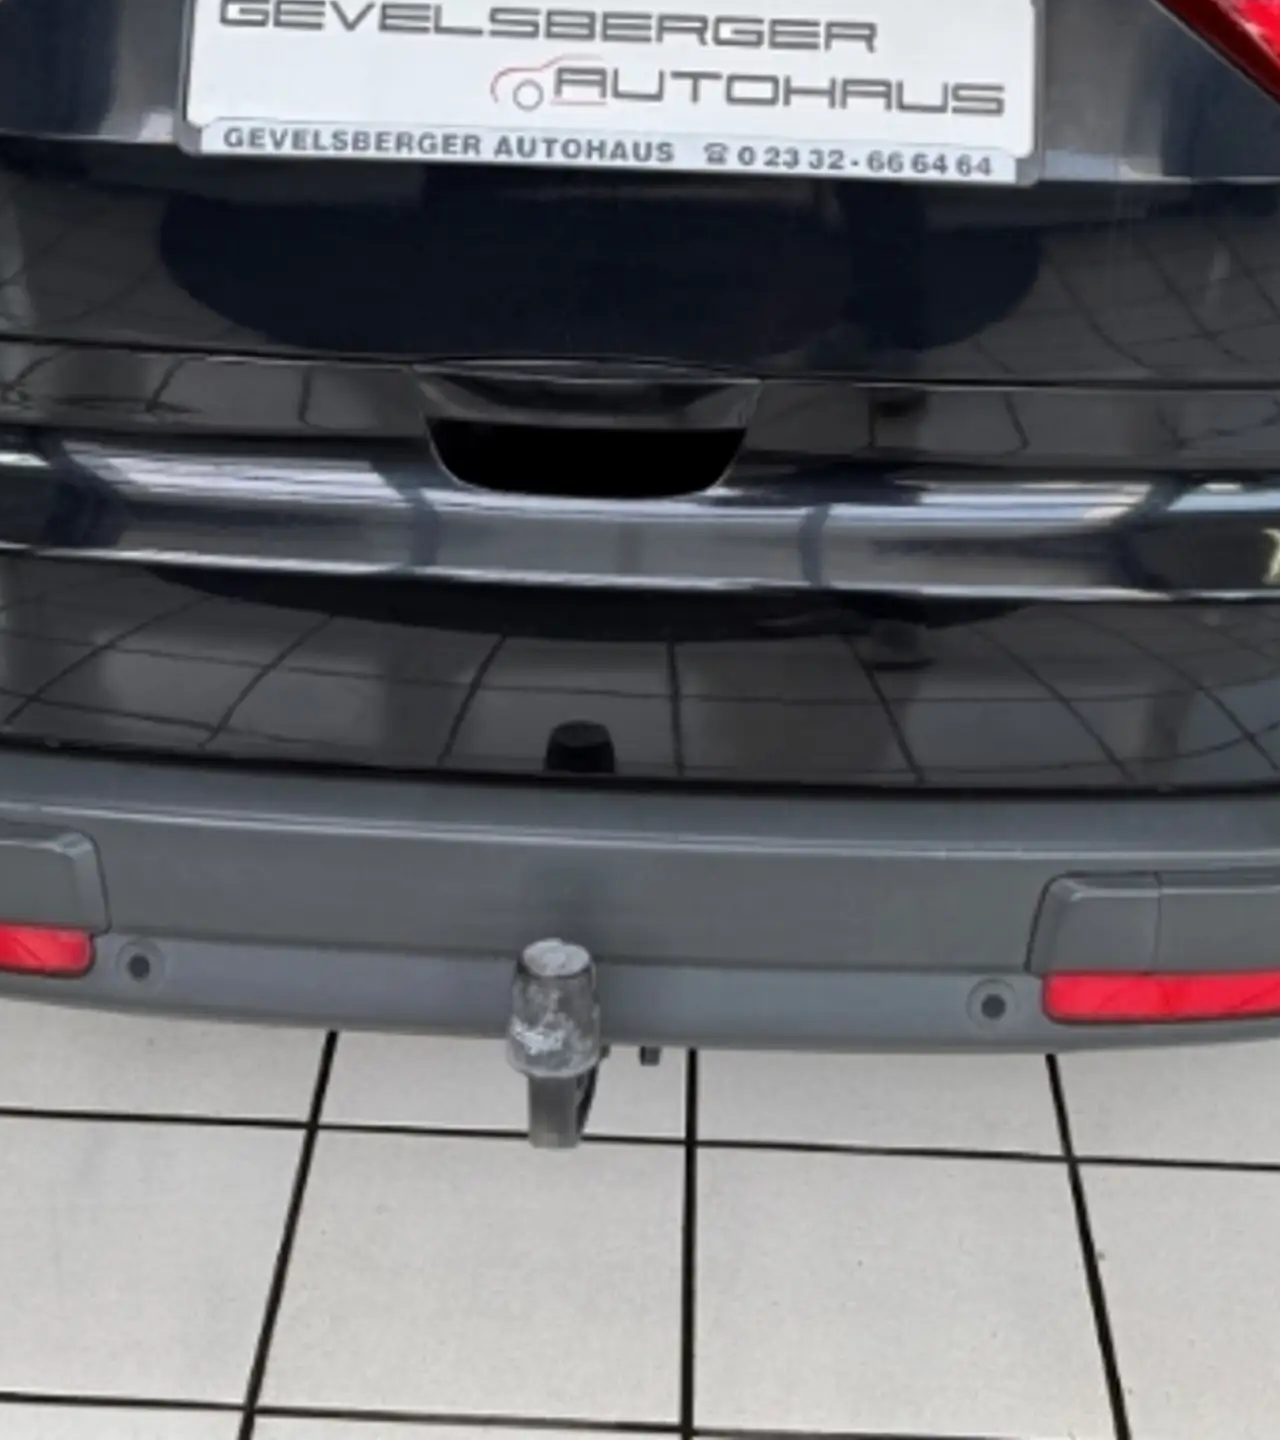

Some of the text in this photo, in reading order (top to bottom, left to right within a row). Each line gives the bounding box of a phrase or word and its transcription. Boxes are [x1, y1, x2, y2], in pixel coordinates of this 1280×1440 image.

[553, 66, 1006, 117] AUTOHAUS
[222, 126, 482, 157] GEVELSBERGER
[493, 134, 676, 163] AUTOHAUS
